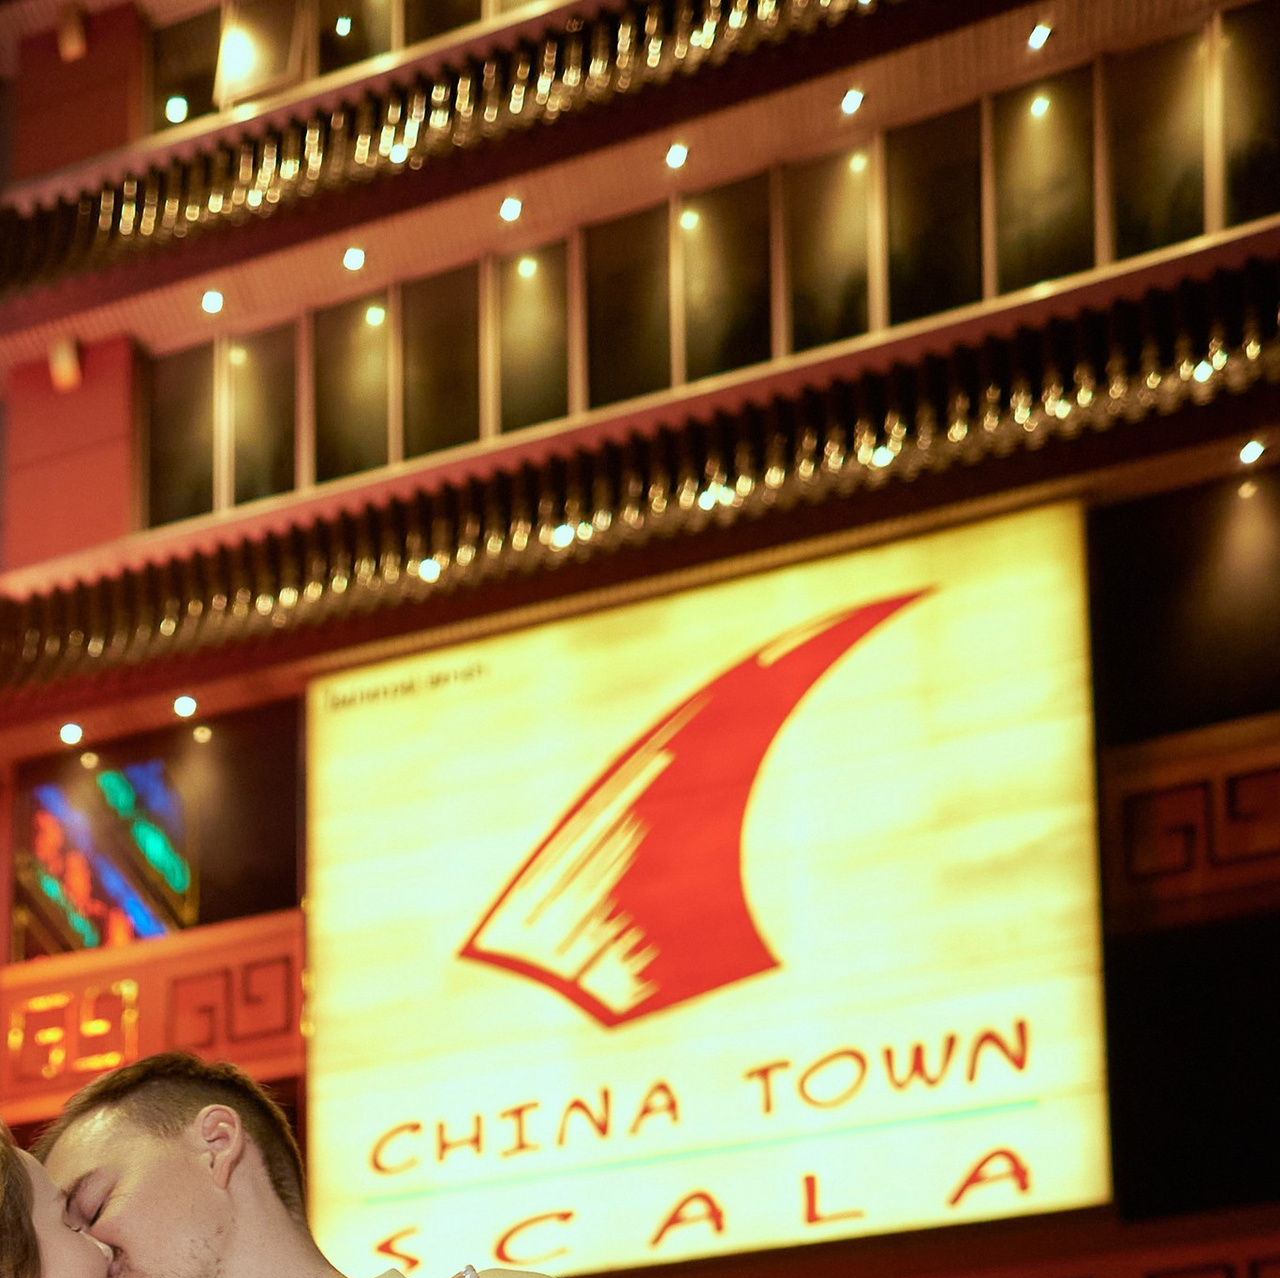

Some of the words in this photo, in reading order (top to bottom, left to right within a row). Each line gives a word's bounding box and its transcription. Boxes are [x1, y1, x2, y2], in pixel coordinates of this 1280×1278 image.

[370, 1087, 679, 1175] CHINA
[742, 1019, 1029, 1114] TOWN
[375, 1148, 1030, 1271] SCALA
